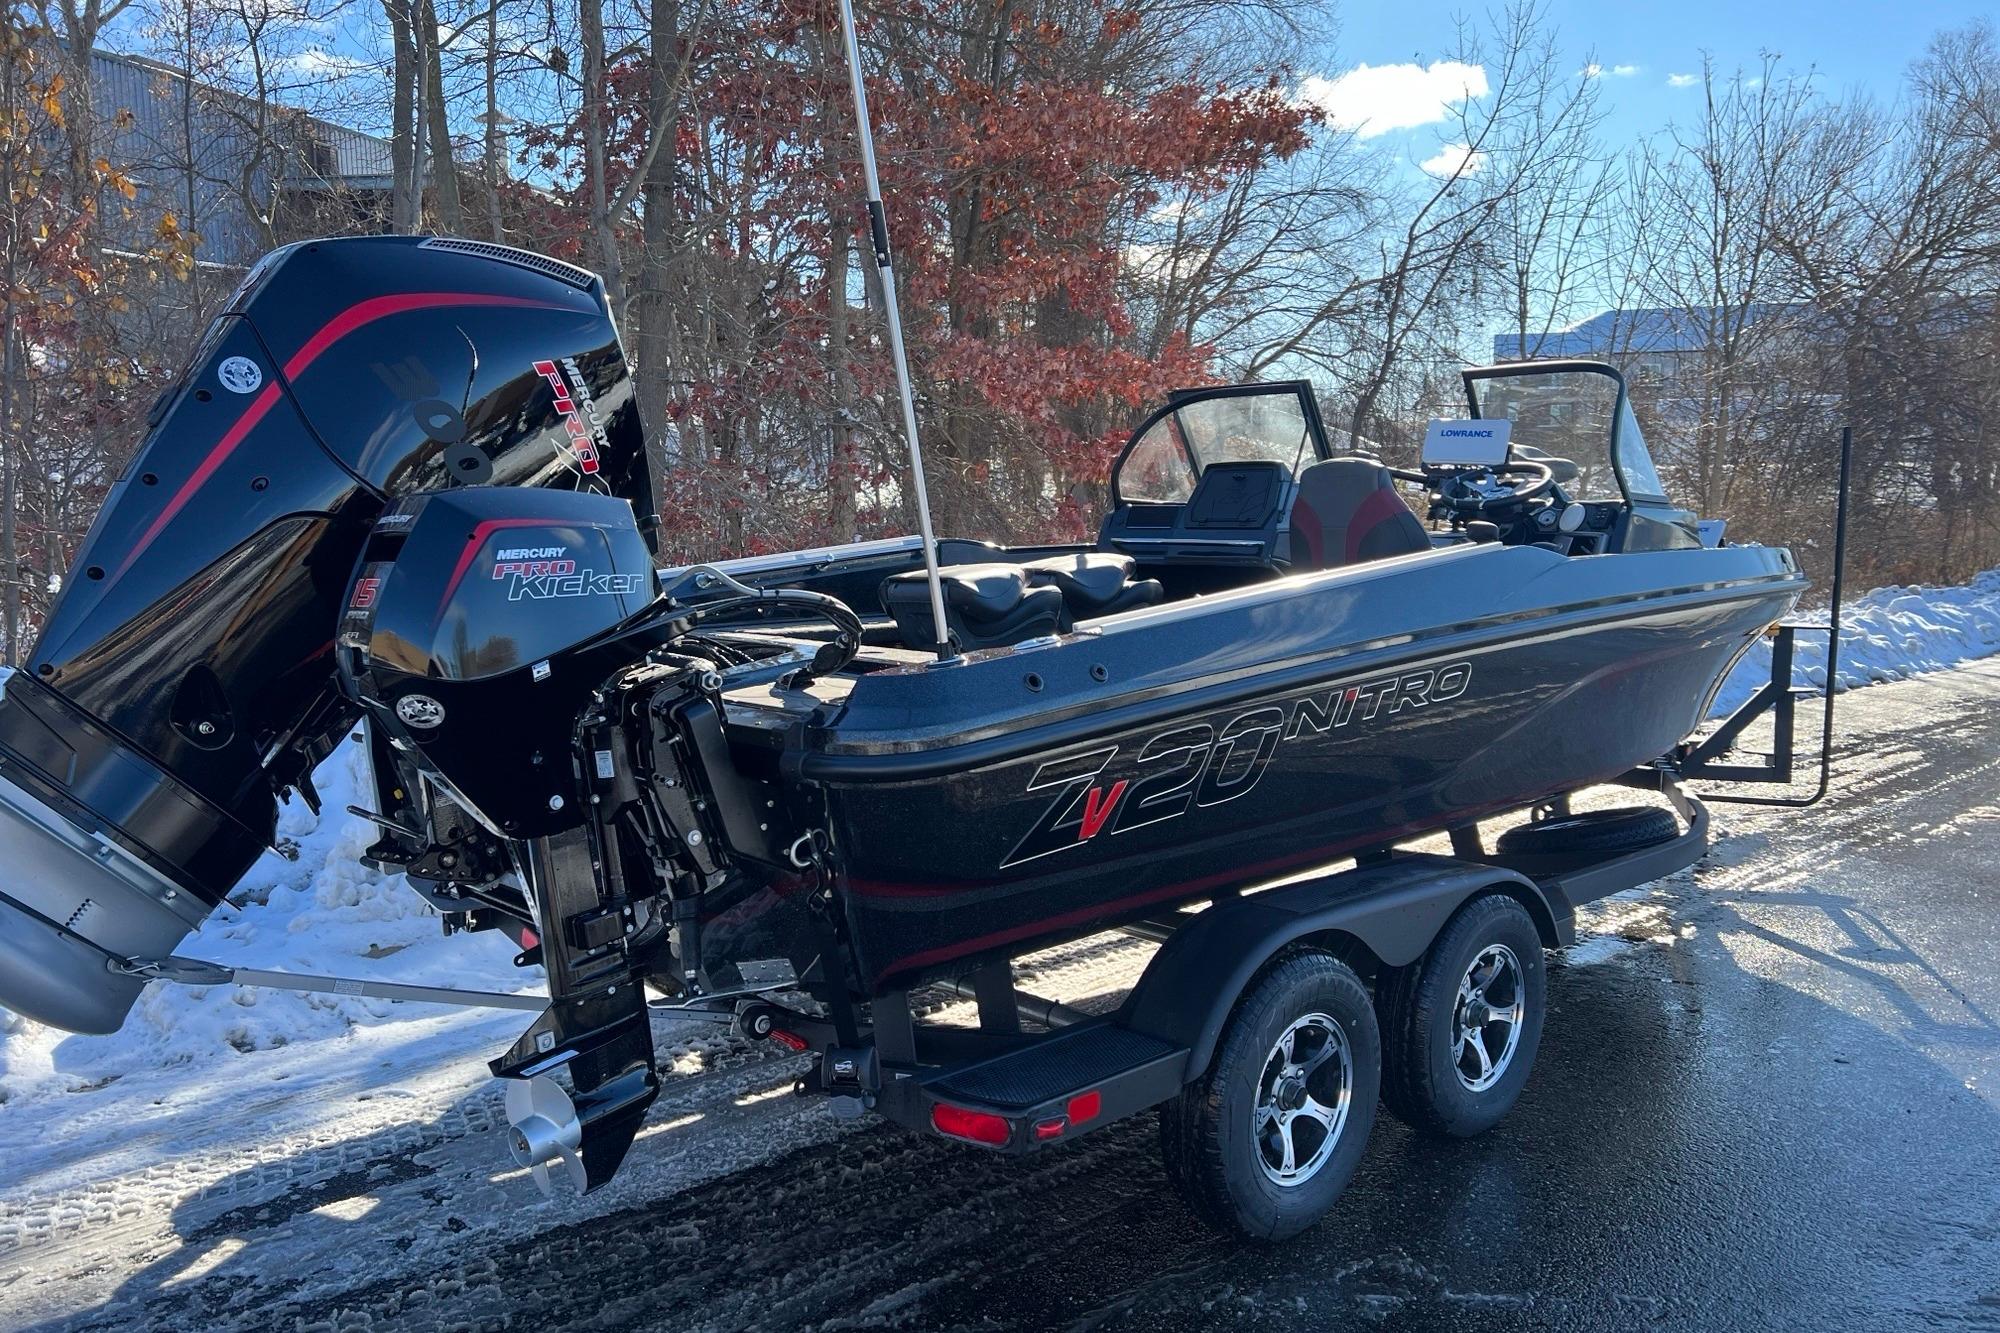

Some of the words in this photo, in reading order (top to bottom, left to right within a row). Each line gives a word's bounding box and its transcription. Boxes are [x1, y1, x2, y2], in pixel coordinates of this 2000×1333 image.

[532, 360, 600, 475] PRO
[561, 357, 611, 448] MERCURY
[1440, 429, 1494, 438] LOWRANCE
[496, 547, 567, 560] MERCURY
[492, 559, 576, 580] PRO
[350, 578, 381, 608] 15
[1284, 662, 1473, 741] NITRO
